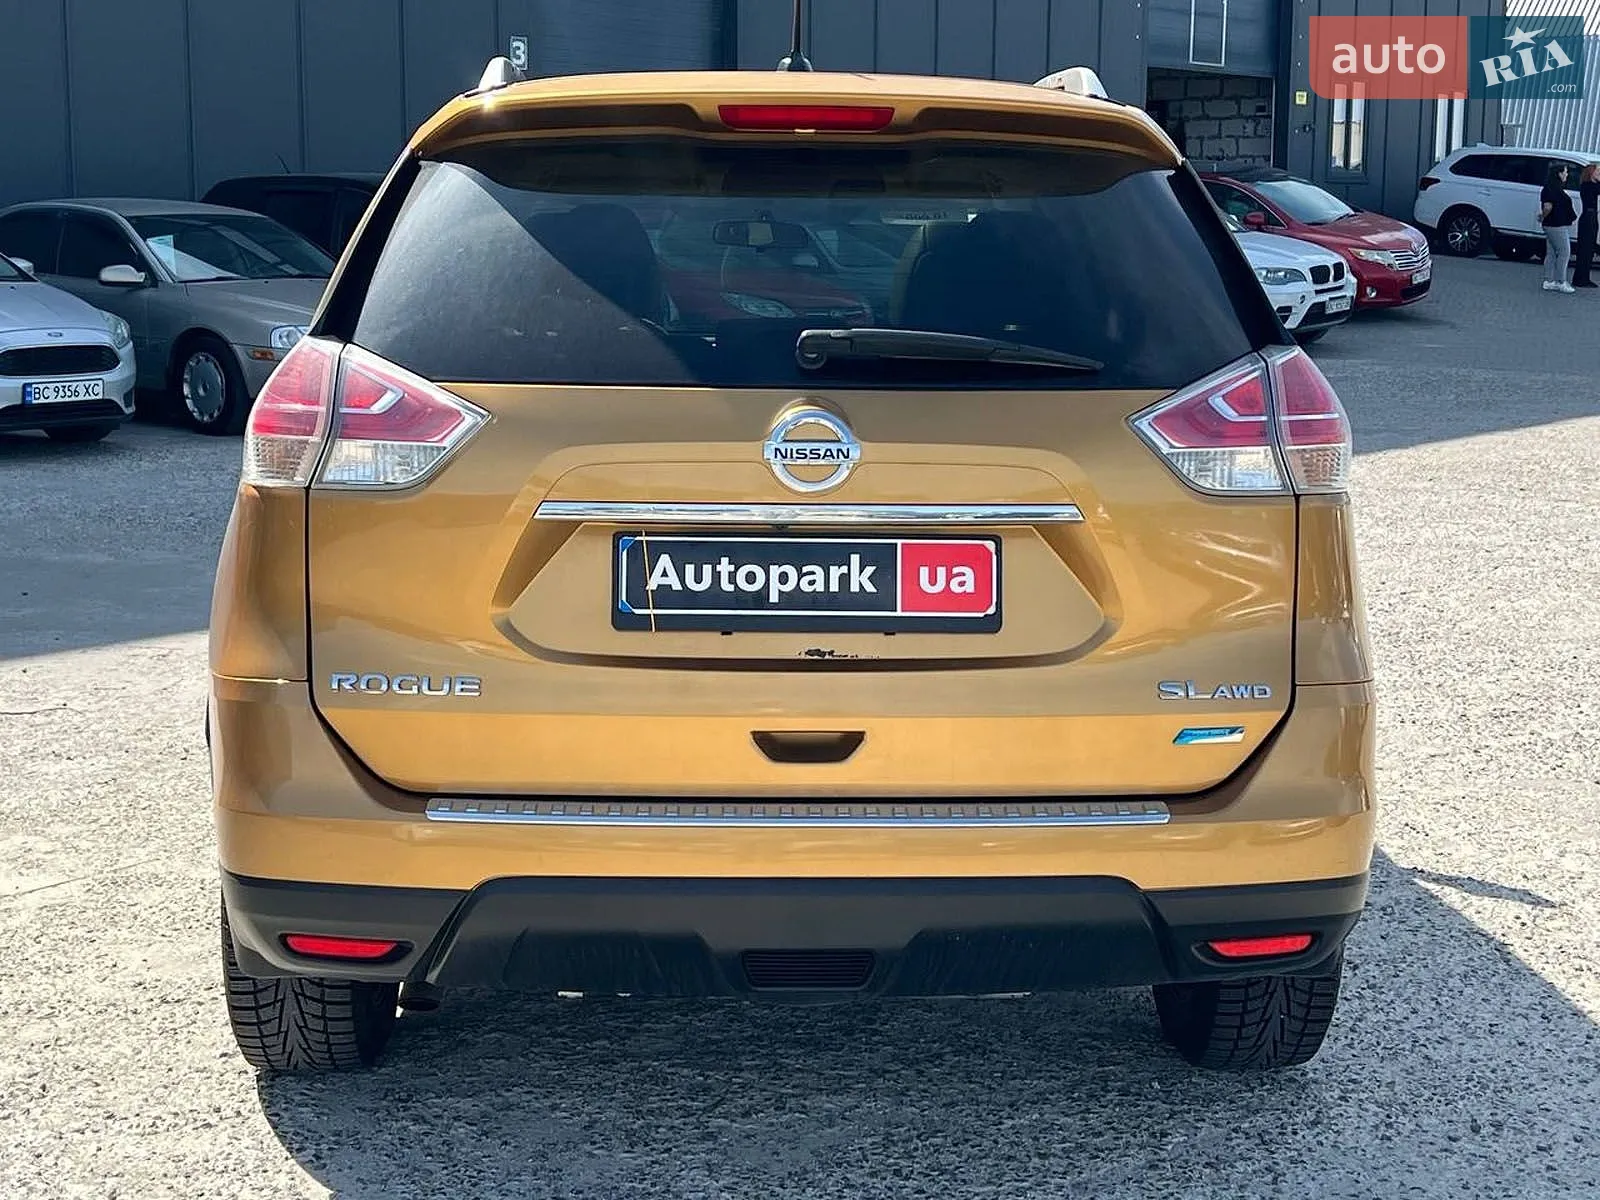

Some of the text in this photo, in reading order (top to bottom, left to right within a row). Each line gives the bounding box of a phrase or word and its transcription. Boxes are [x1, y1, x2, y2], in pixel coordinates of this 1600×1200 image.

[512, 40, 525, 65] 3
[33, 385, 50, 400] BC
[53, 384, 80, 399] 9356
[83, 383, 100, 397] XC
[774, 447, 850, 460] NISSAN
[646, 553, 976, 603] Autopark ua
[330, 672, 481, 696] ROGUE
